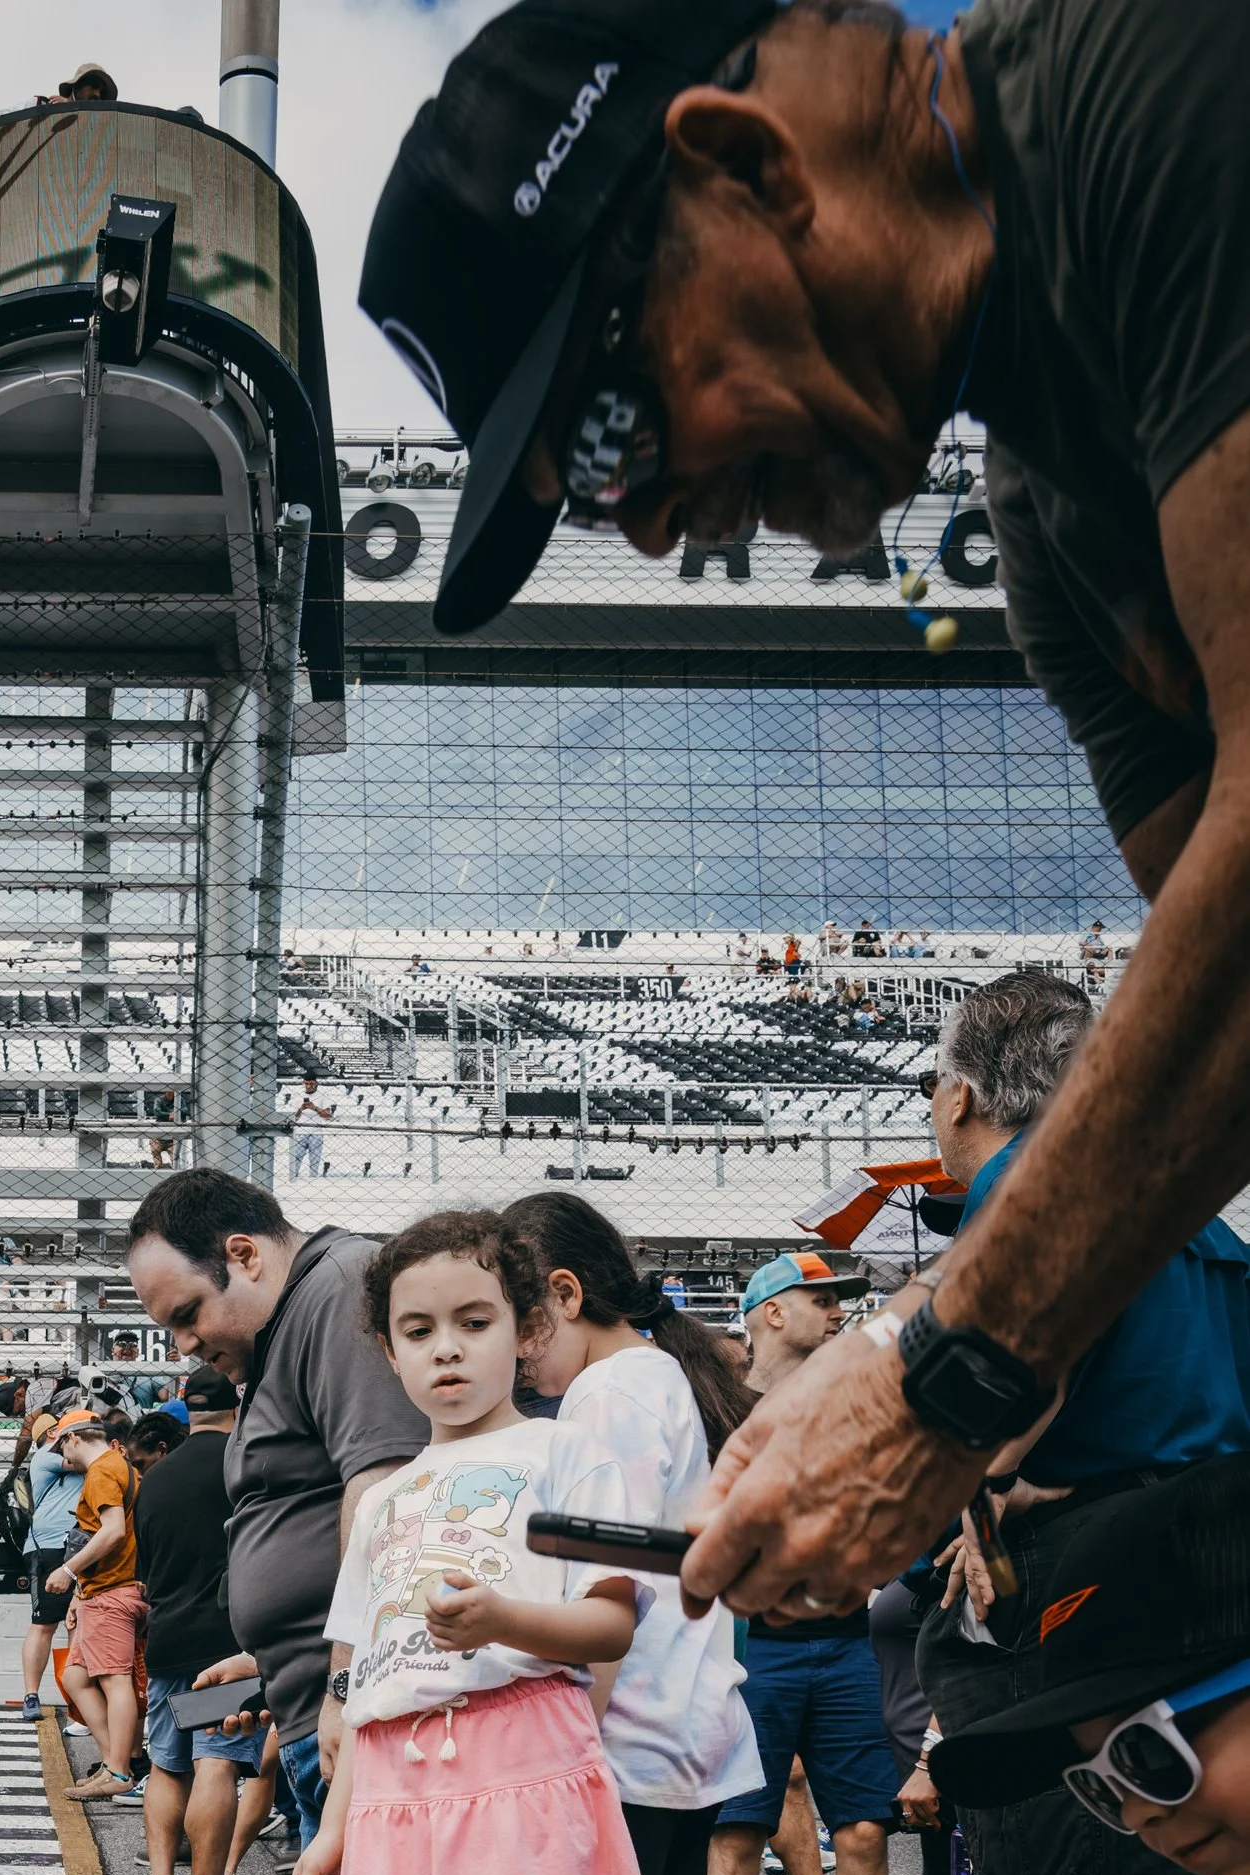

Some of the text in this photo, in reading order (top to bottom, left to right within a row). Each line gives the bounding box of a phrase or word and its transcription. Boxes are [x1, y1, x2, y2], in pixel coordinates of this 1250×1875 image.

[533, 62, 619, 193] ACURA
[119, 204, 161, 219] WHELEN
[636, 977, 674, 1001] 350
[707, 1275, 735, 1293] 145
[354, 1637, 408, 1689] Hello
[392, 1657, 450, 1673] Friends
